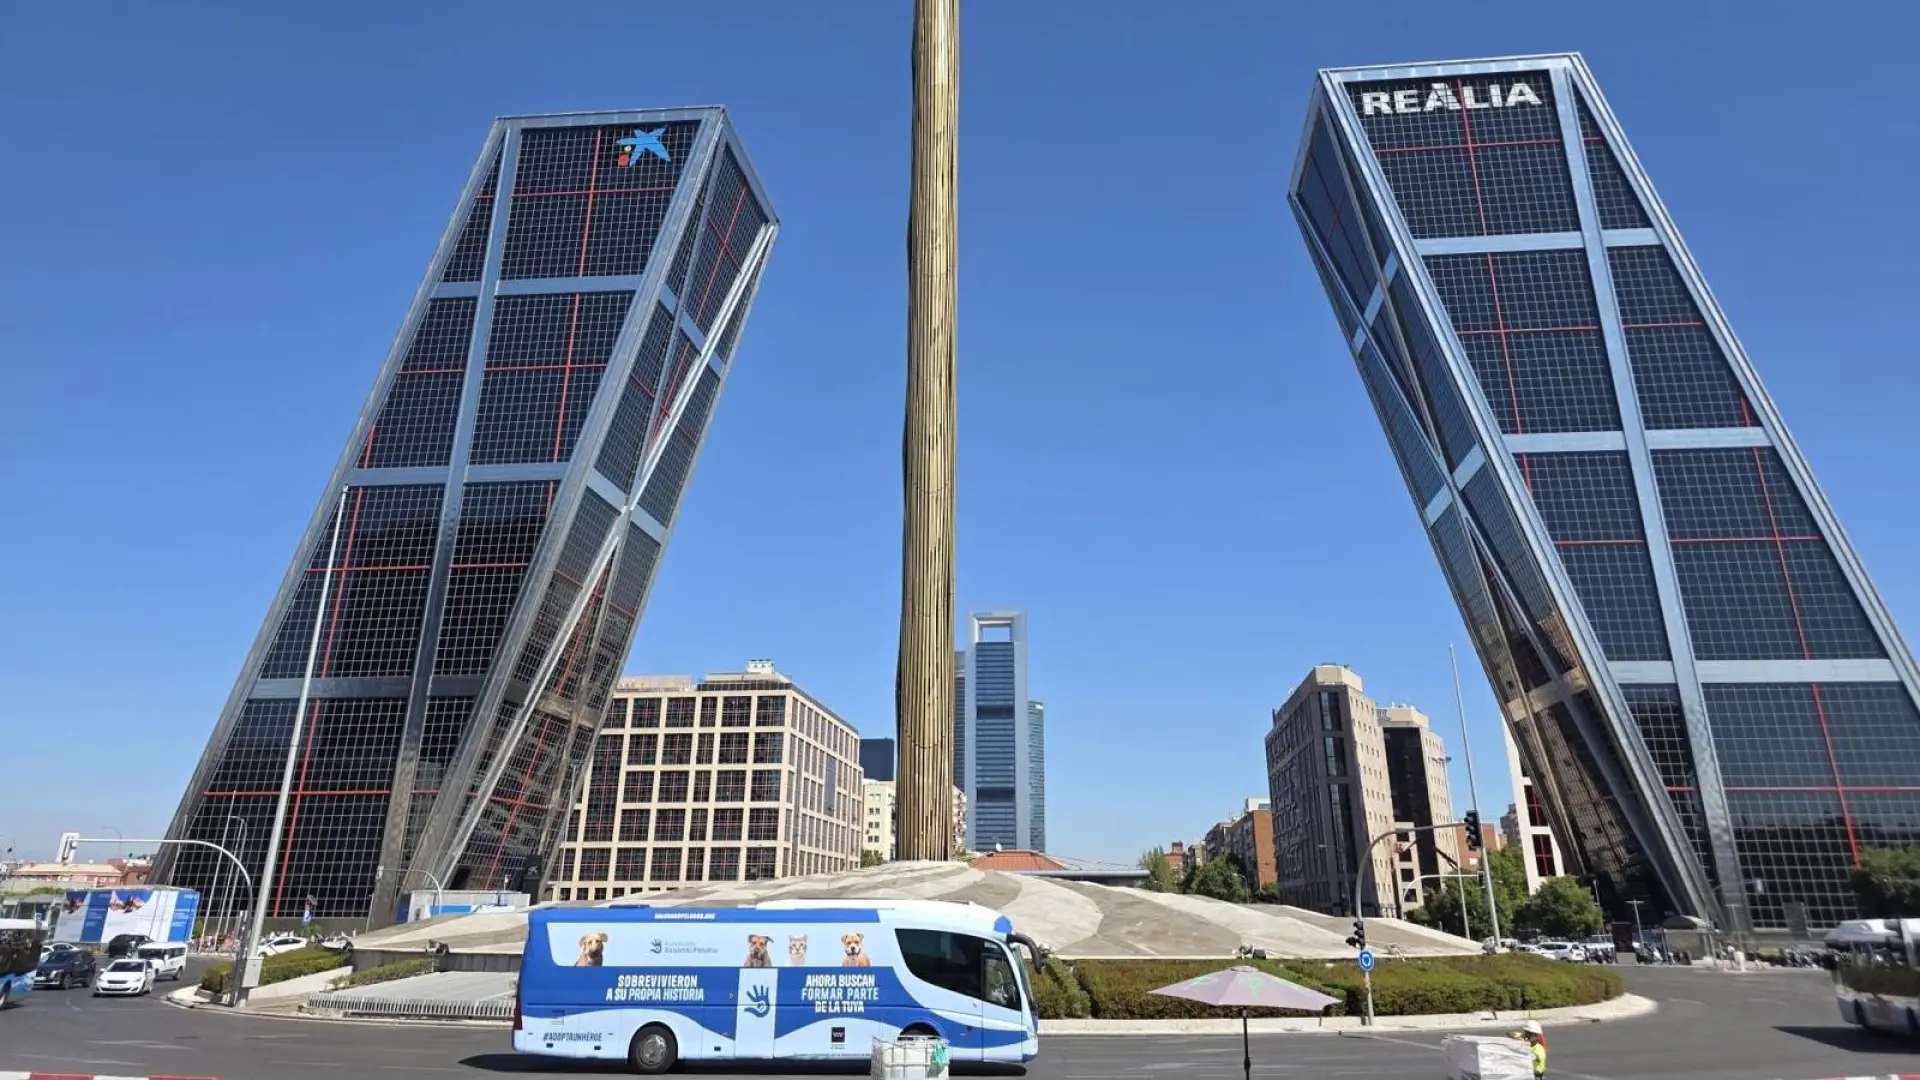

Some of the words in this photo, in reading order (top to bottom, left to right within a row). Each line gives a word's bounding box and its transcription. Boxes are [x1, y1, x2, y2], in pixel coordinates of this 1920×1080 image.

[1362, 83, 1542, 115] REALIA
[618, 974, 698, 987] SOBREVIVIERON
[806, 974, 837, 987] AHORA
[838, 974, 876, 987] BUSCAN
[606, 988, 613, 1001] A
[614, 988, 627, 1001] SU
[628, 988, 661, 1001] PROPIA
[663, 988, 704, 1001] HISTORIA
[801, 988, 843, 1000] FORMAR
[847, 988, 879, 1000] PARTE
[815, 1001, 827, 1013] DE
[828, 1001, 840, 1013] LA
[841, 1001, 864, 1013] TUYA
